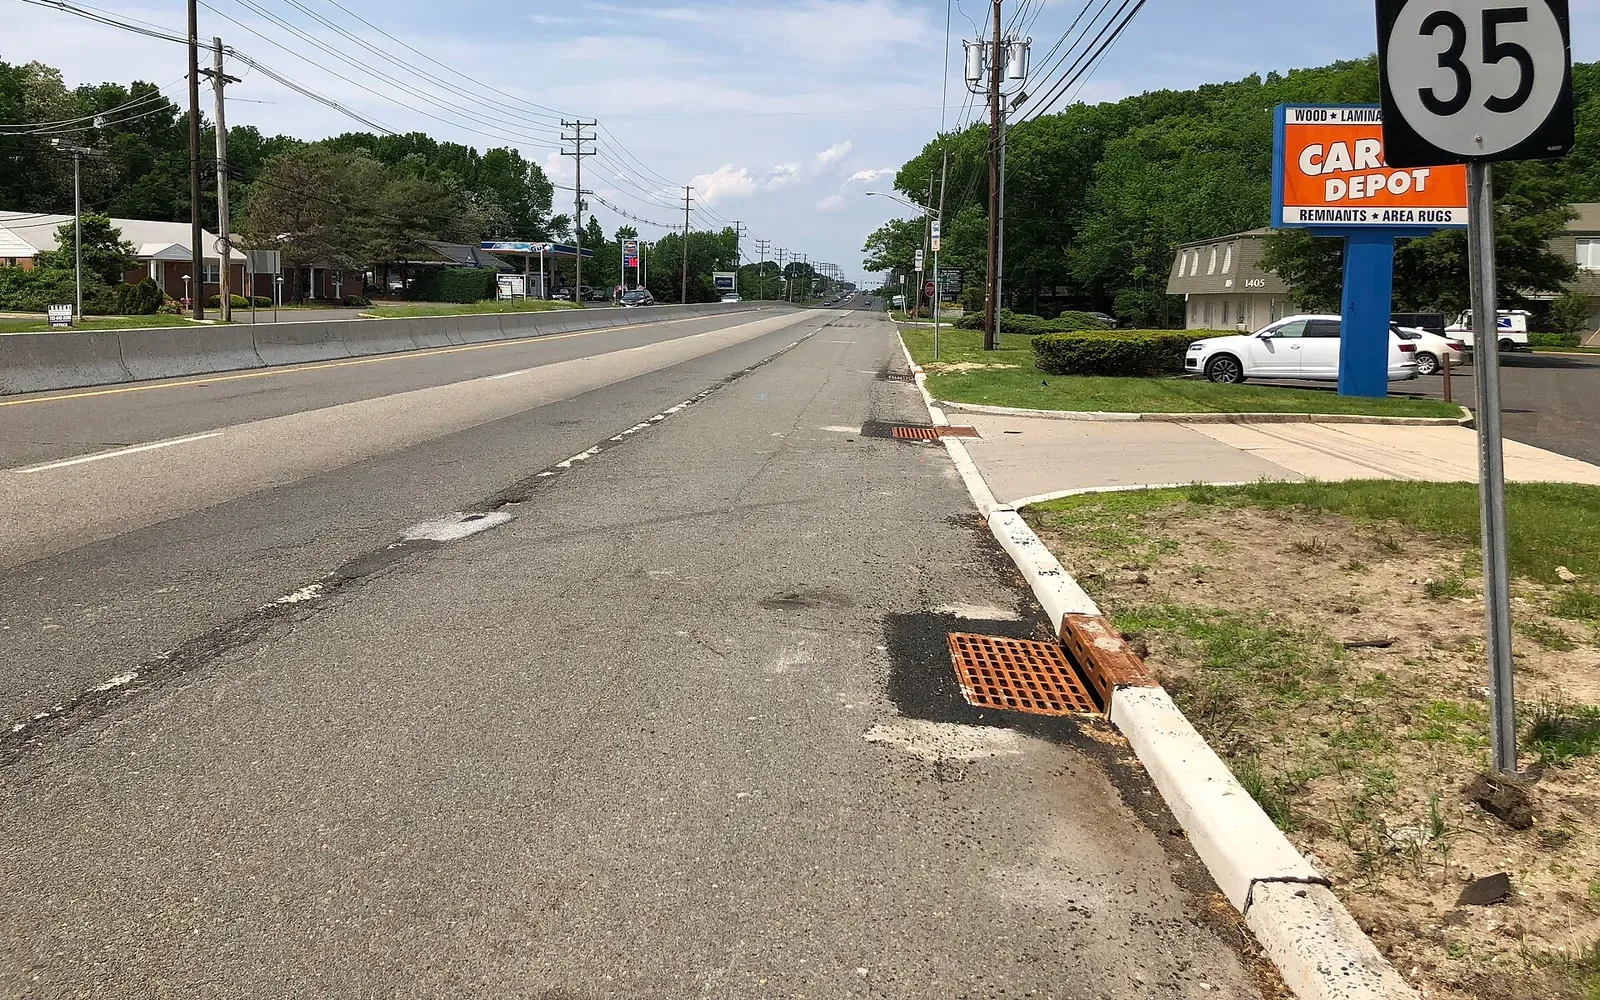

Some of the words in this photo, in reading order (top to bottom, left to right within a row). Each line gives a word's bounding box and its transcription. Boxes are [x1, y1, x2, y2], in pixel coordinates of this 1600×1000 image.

[1418, 7, 1534, 116] 35
[1295, 109, 1327, 122] WOOD
[1341, 109, 1383, 122] LAMINA
[1298, 138, 1388, 176] CAR
[1324, 168, 1430, 202] DEPOT
[1299, 209, 1367, 222] REMNANTS
[1382, 210, 1414, 222] AREA
[1418, 210, 1452, 222] RUGS
[1245, 278, 1265, 288] 1405
